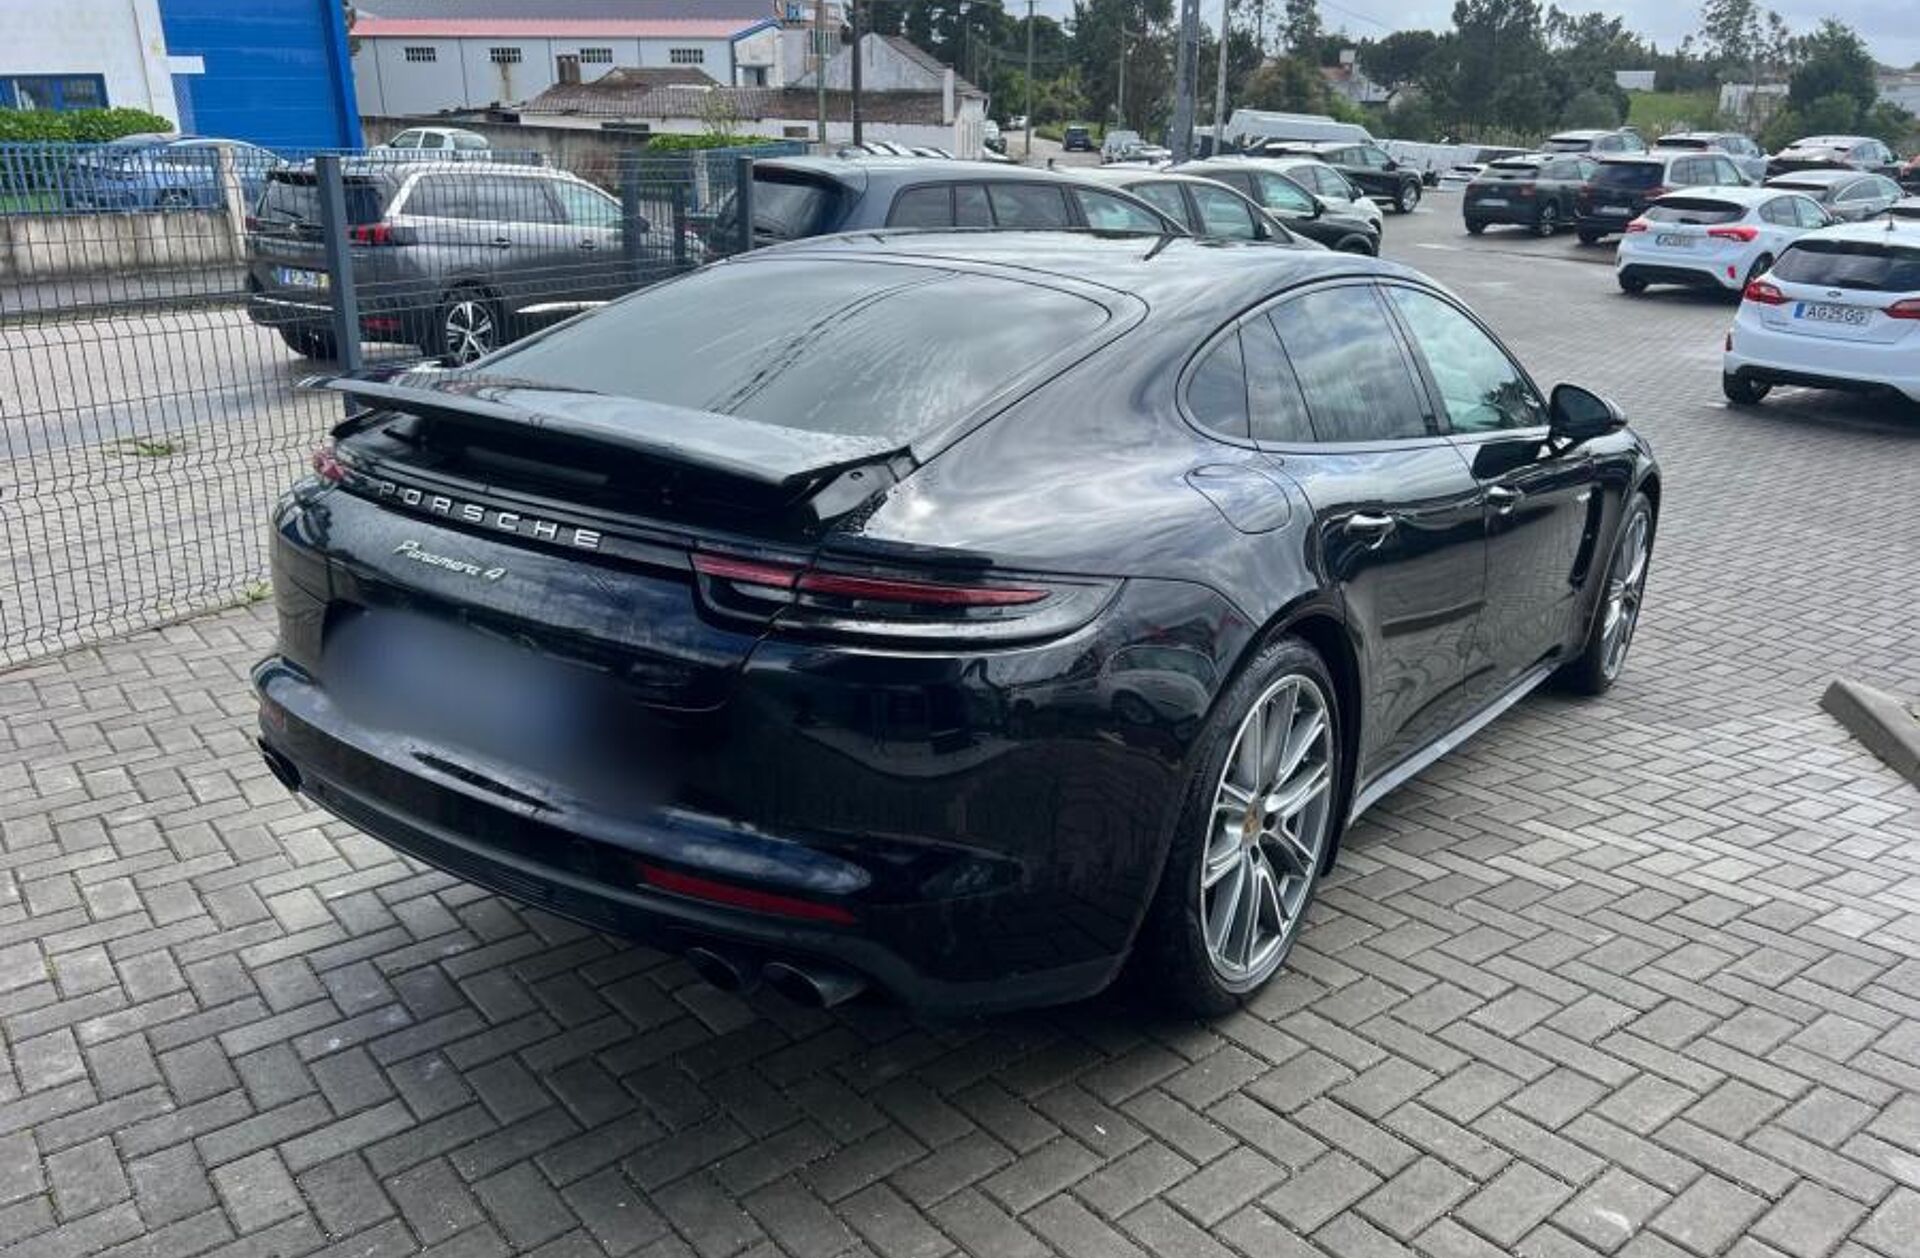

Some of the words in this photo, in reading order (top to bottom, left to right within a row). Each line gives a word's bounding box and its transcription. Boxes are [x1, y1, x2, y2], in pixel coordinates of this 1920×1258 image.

[379, 482, 601, 549] PORSCHE
[391, 540, 481, 576] Panamera
[484, 567, 507, 580] 4
